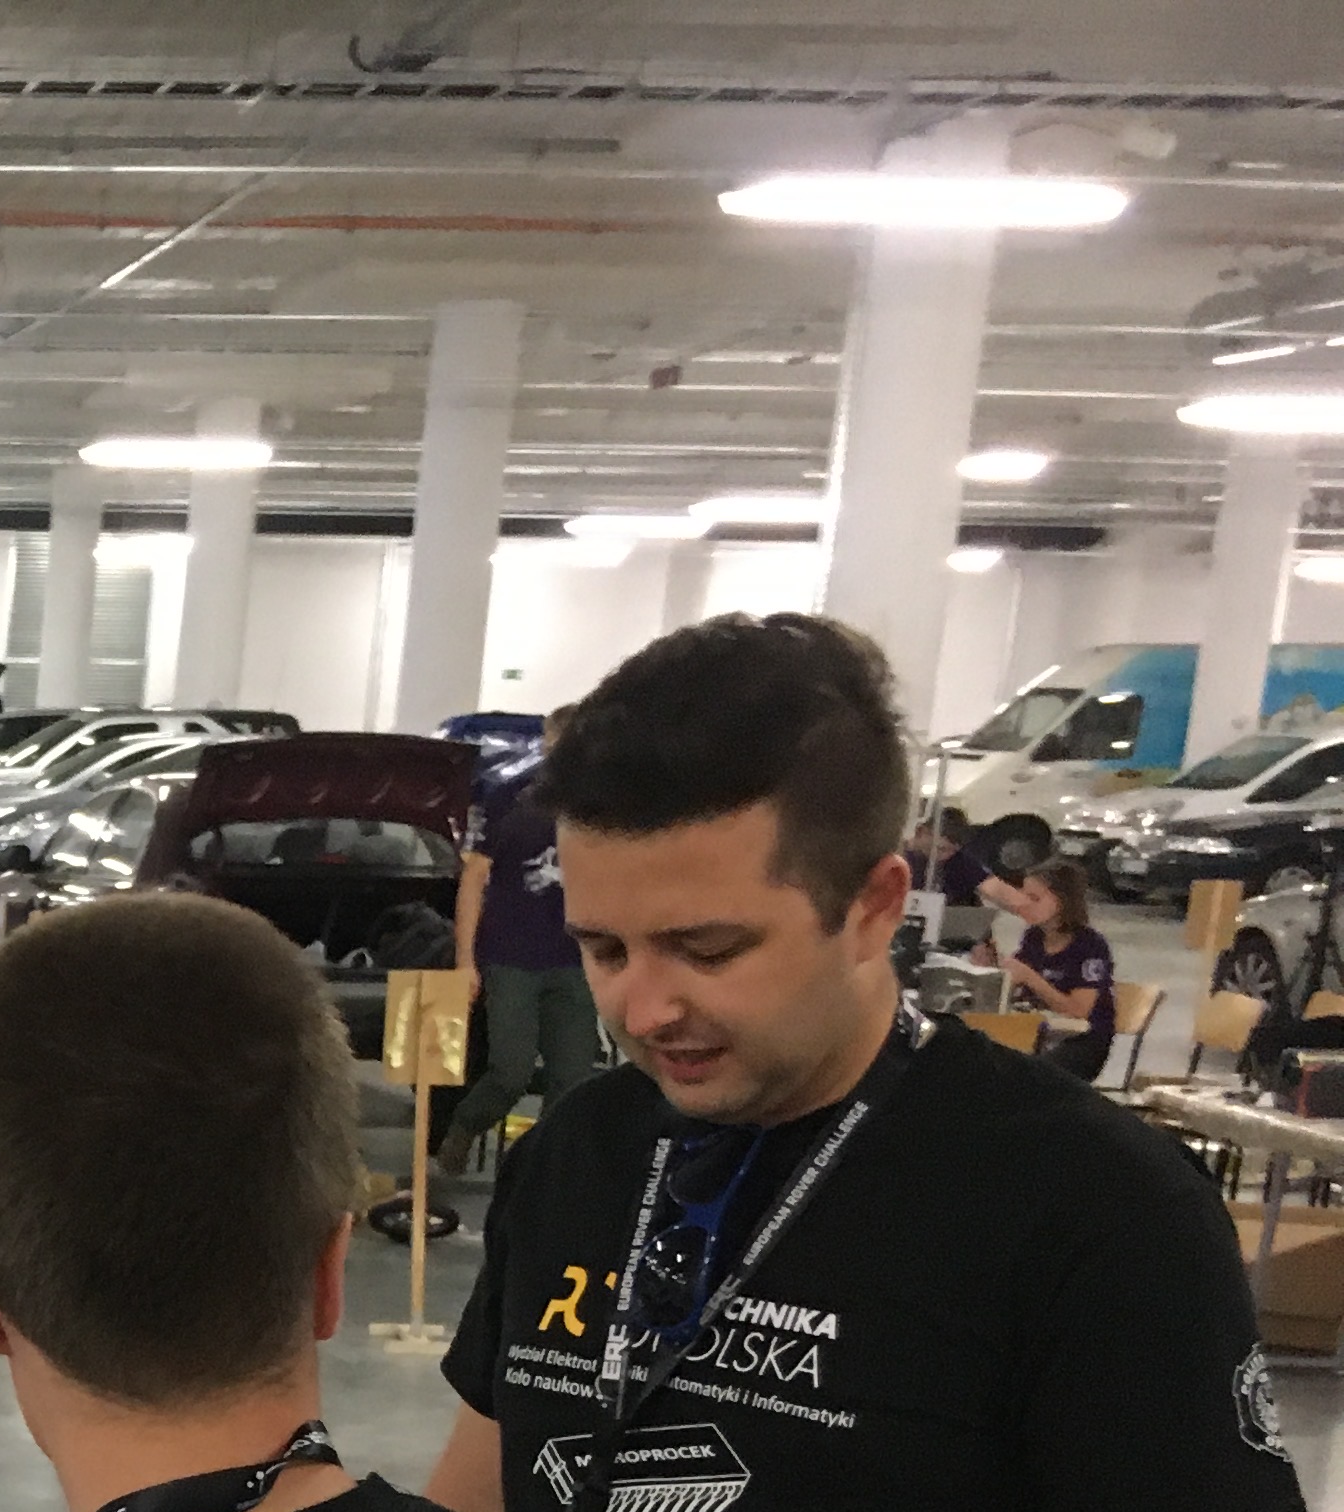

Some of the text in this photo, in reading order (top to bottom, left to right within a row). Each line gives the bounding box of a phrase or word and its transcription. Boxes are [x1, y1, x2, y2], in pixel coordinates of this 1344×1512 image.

[743, 1100, 869, 1266] EUROPEAN ROVER CHALLENGE
[617, 1137, 672, 1311] EUROPEAN ROVER CHALLENGE
[723, 1296, 839, 1340] CHNIKA
[602, 1324, 630, 1380] ERC
[533, 1374, 595, 1398] naukow
[751, 1392, 856, 1429] Informatyki
